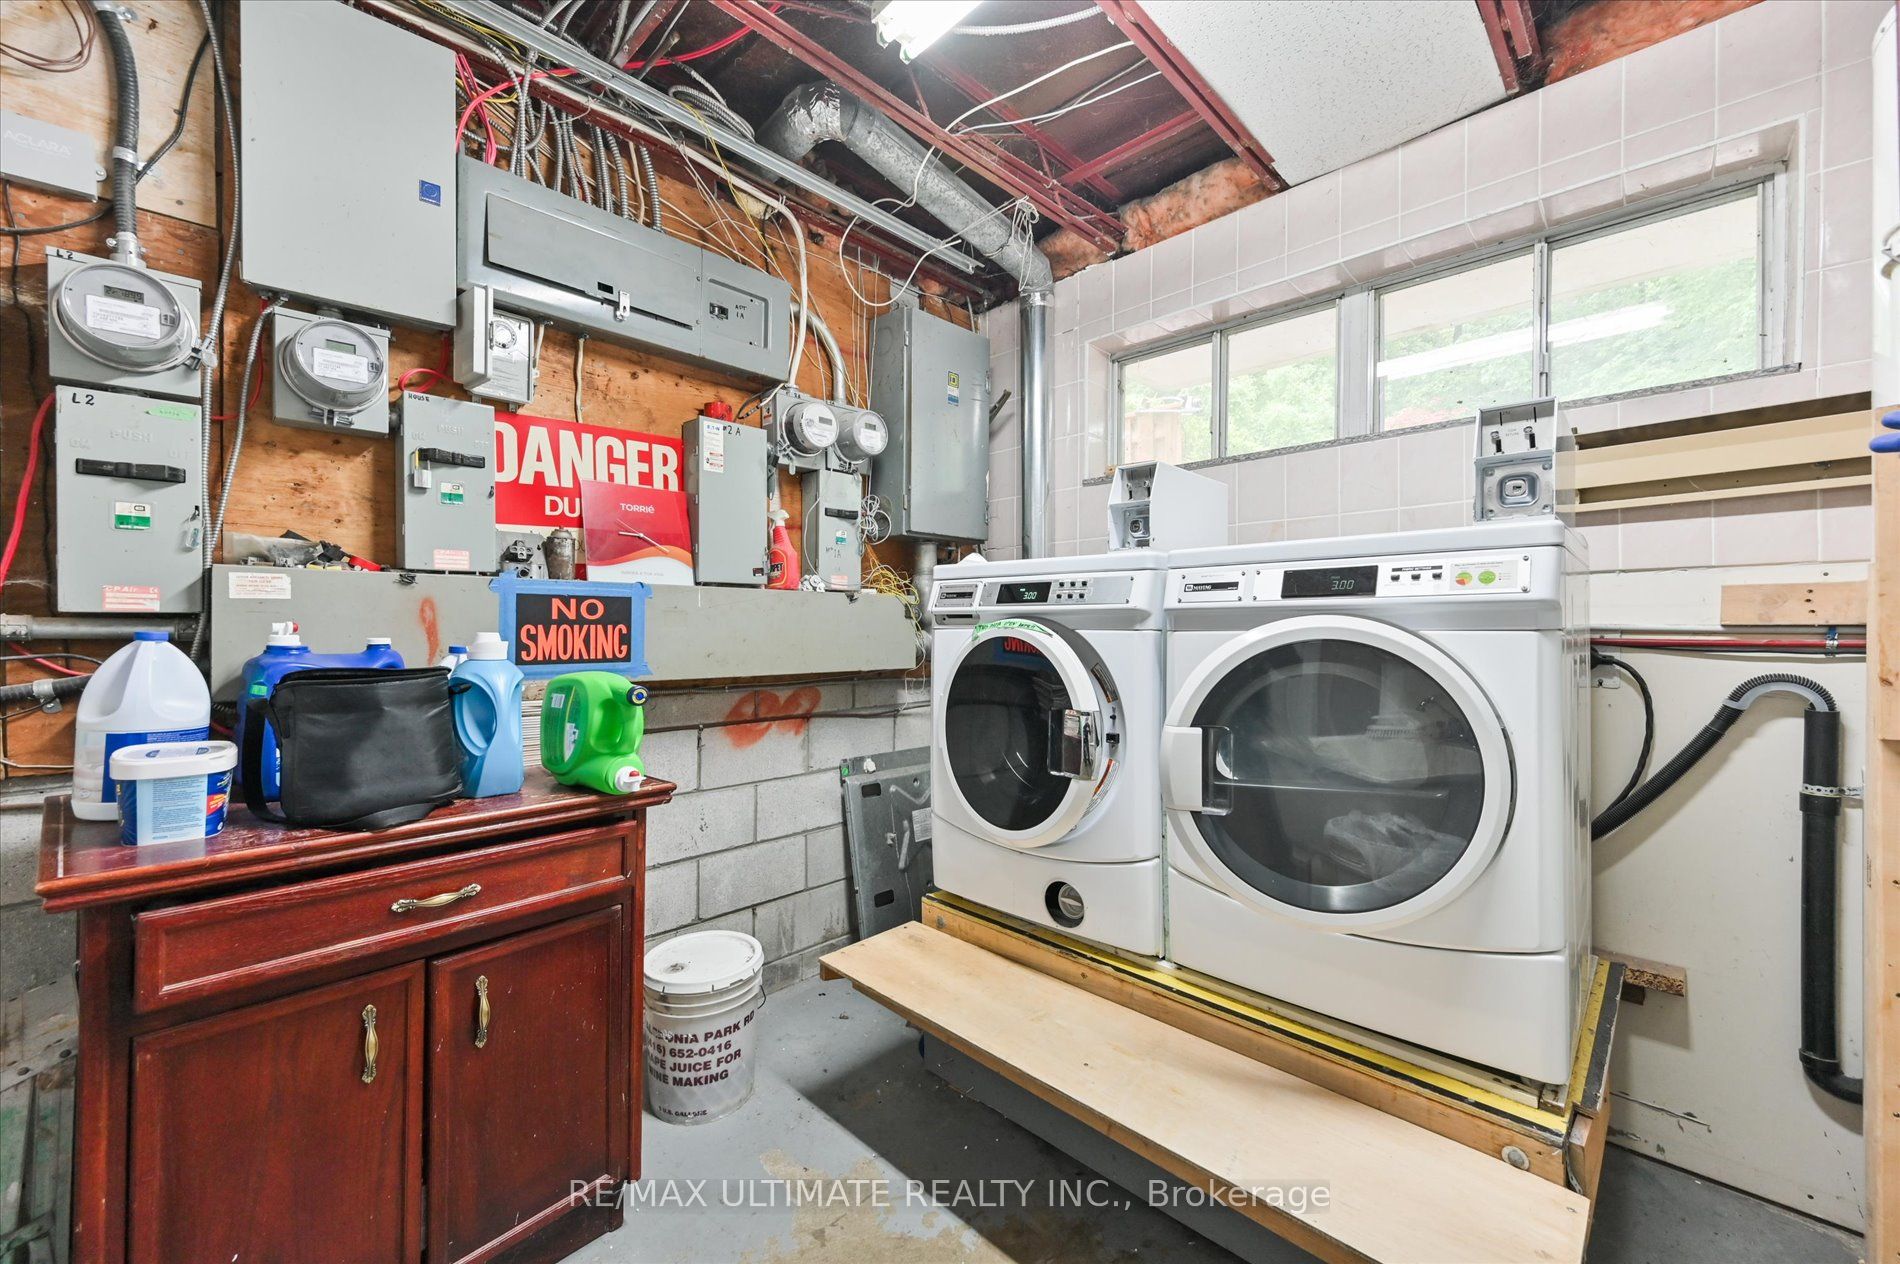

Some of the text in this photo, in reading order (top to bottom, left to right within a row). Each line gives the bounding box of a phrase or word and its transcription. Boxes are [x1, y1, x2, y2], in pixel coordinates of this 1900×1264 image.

[494, 420, 679, 492] DANGER
[551, 598, 605, 620] NO
[520, 623, 628, 661] SMOKING
[704, 1020, 741, 1043] PARK
[743, 1009, 755, 1028] RD
[670, 1040, 732, 1058] 652-0416
[670, 1058, 712, 1073] JUICE
[716, 1048, 742, 1067] FOR
[673, 1069, 729, 1087] MAKING
